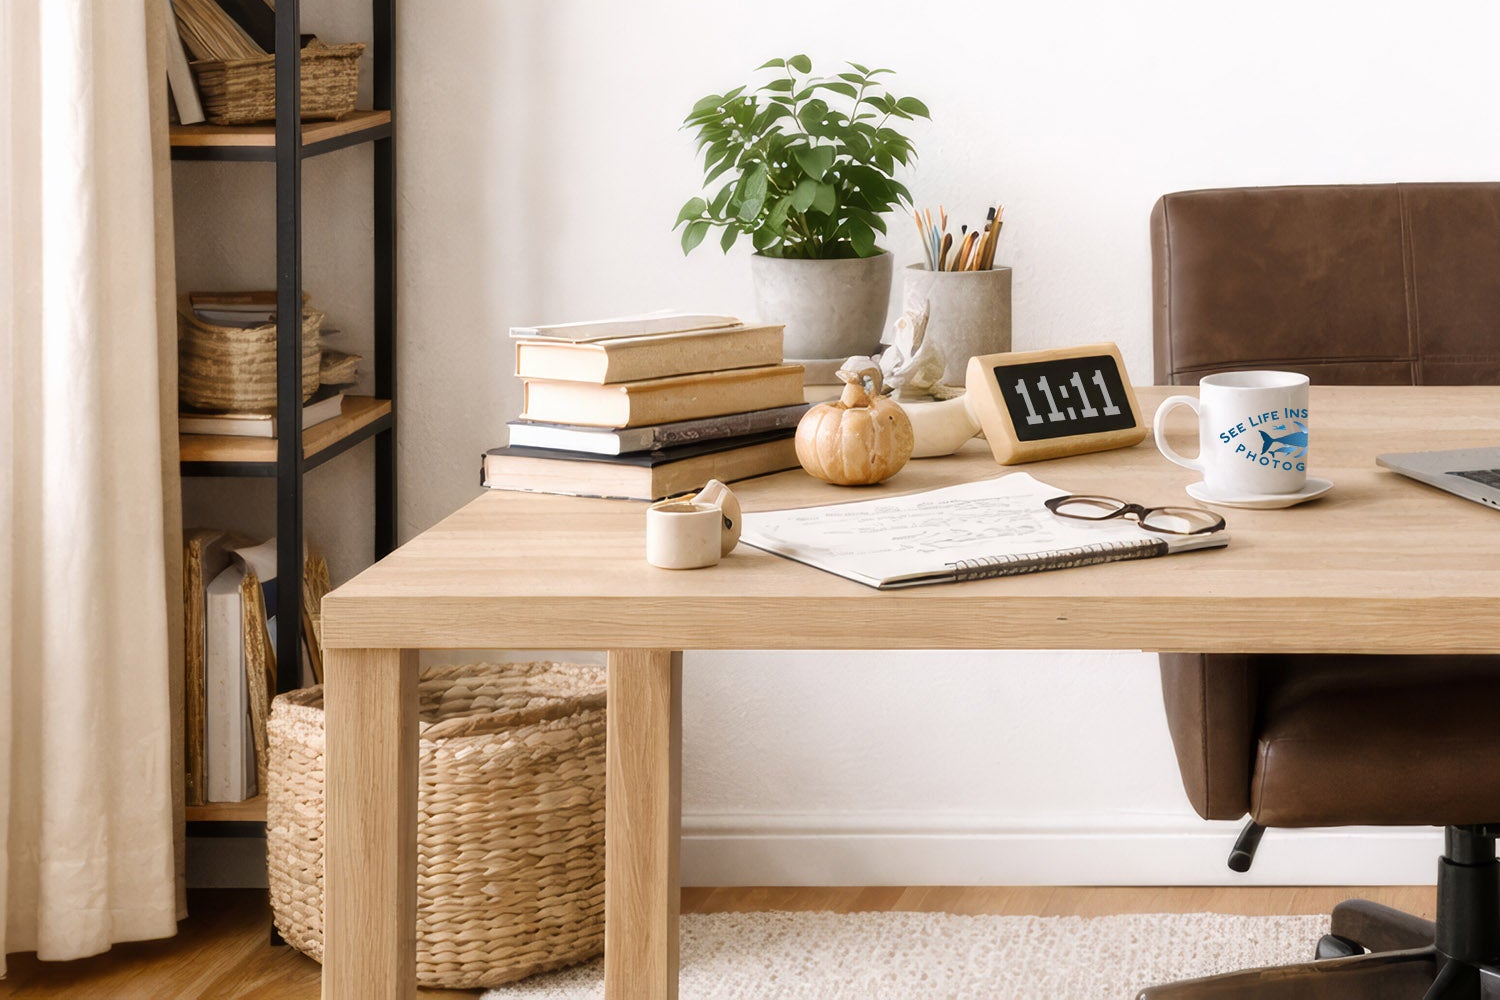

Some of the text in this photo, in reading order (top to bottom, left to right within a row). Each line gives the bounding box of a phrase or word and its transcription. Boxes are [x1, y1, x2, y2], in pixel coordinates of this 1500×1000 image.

[1015, 369, 1121, 425] 11:11
[1219, 422, 1247, 444] SEE
[1248, 410, 1280, 428] LIFE
